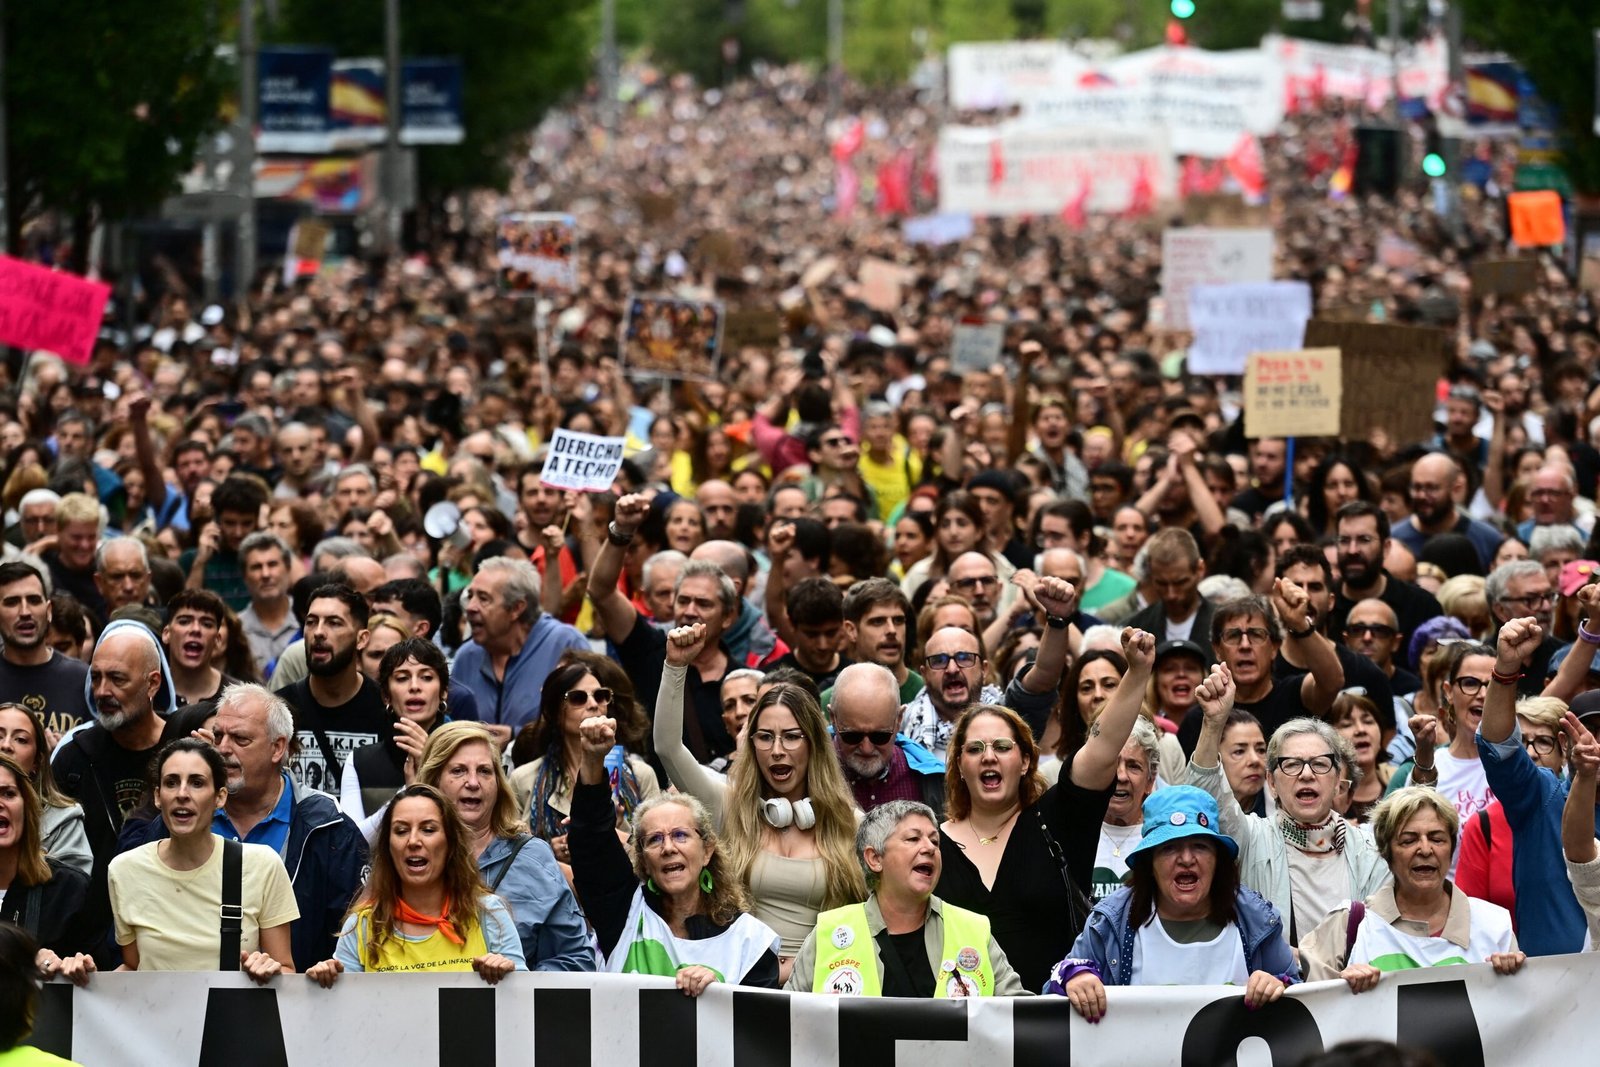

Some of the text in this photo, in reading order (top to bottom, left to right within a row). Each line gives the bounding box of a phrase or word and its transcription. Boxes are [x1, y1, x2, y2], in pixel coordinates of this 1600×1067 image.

[554, 436, 623, 460] DERECHO
[548, 456, 617, 478] A TECHO
[449, 957, 475, 965] INFANC
[828, 958, 861, 971] COESPE
